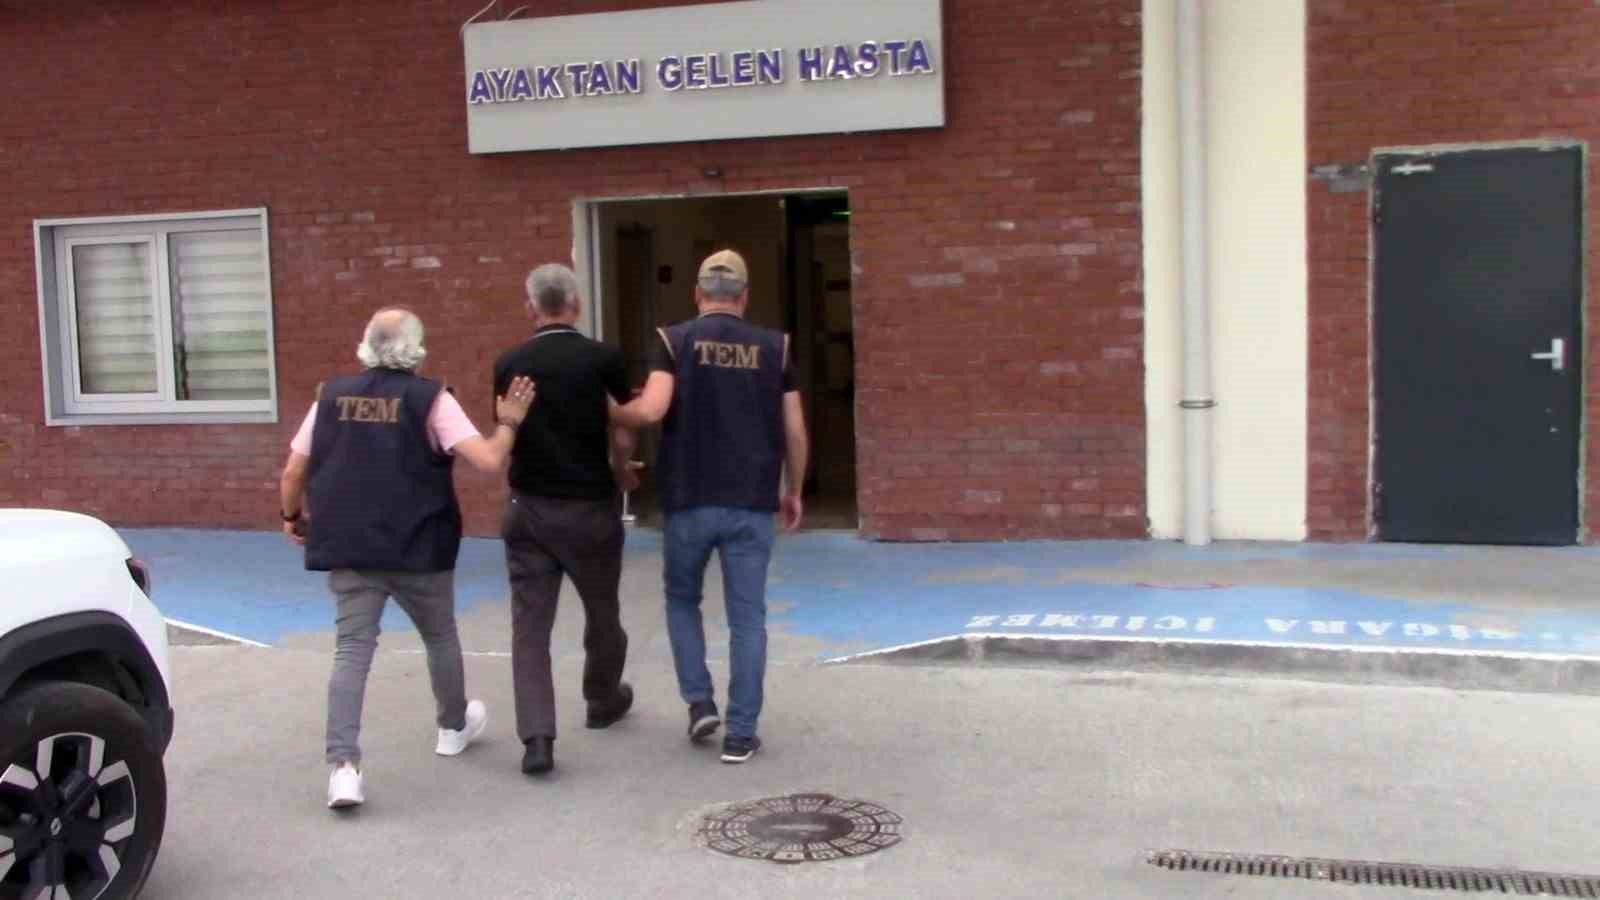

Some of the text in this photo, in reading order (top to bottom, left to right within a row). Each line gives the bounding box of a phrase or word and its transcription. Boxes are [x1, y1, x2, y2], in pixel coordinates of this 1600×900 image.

[468, 39, 934, 103] AYAKTAN GELEN HASTA
[694, 340, 760, 369] TEM
[336, 395, 401, 423] TEM
